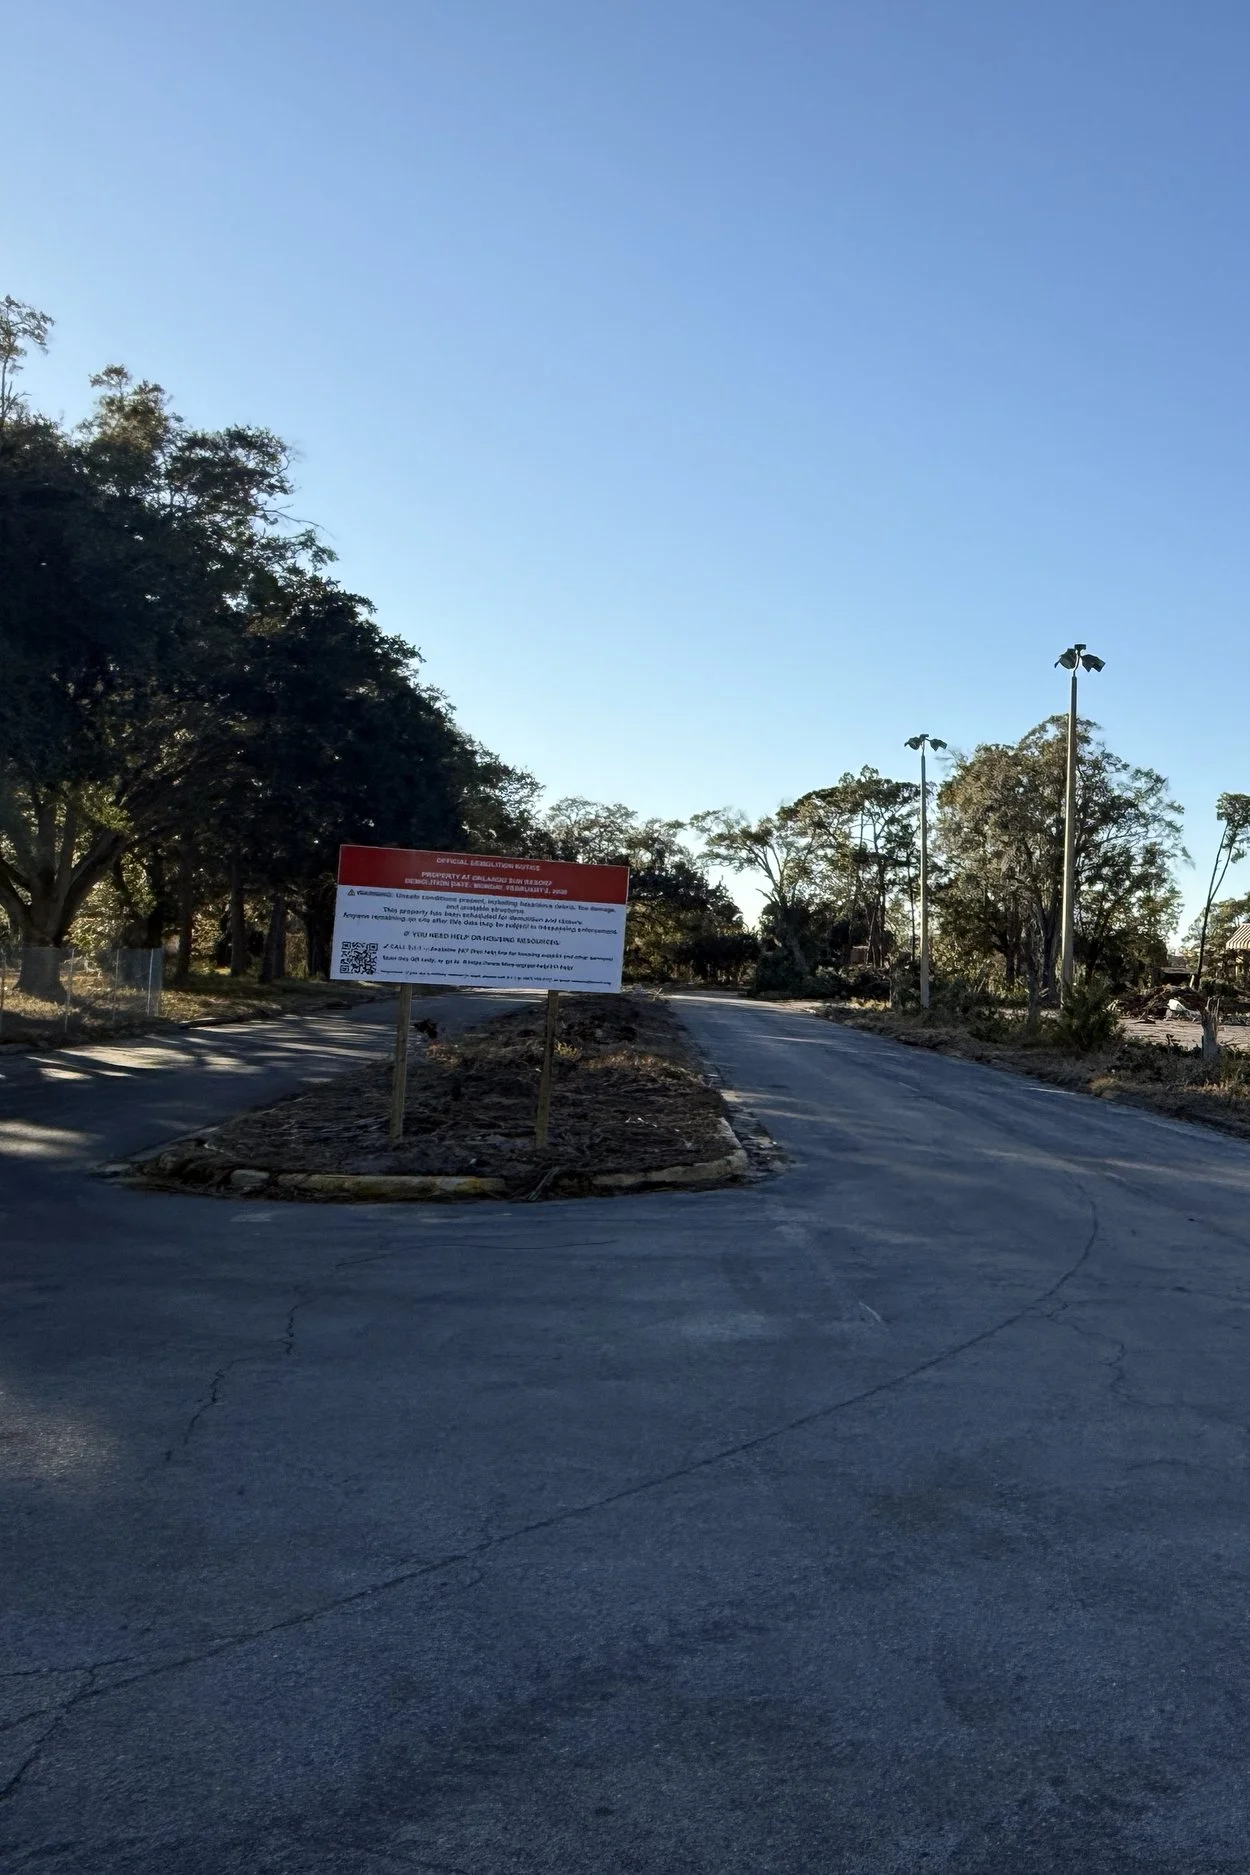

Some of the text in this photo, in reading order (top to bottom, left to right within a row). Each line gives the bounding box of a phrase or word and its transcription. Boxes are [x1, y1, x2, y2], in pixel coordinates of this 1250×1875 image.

[436, 857, 469, 865] OFFICIAL
[421, 871, 459, 880] PROPERTY
[399, 908, 427, 916] property
